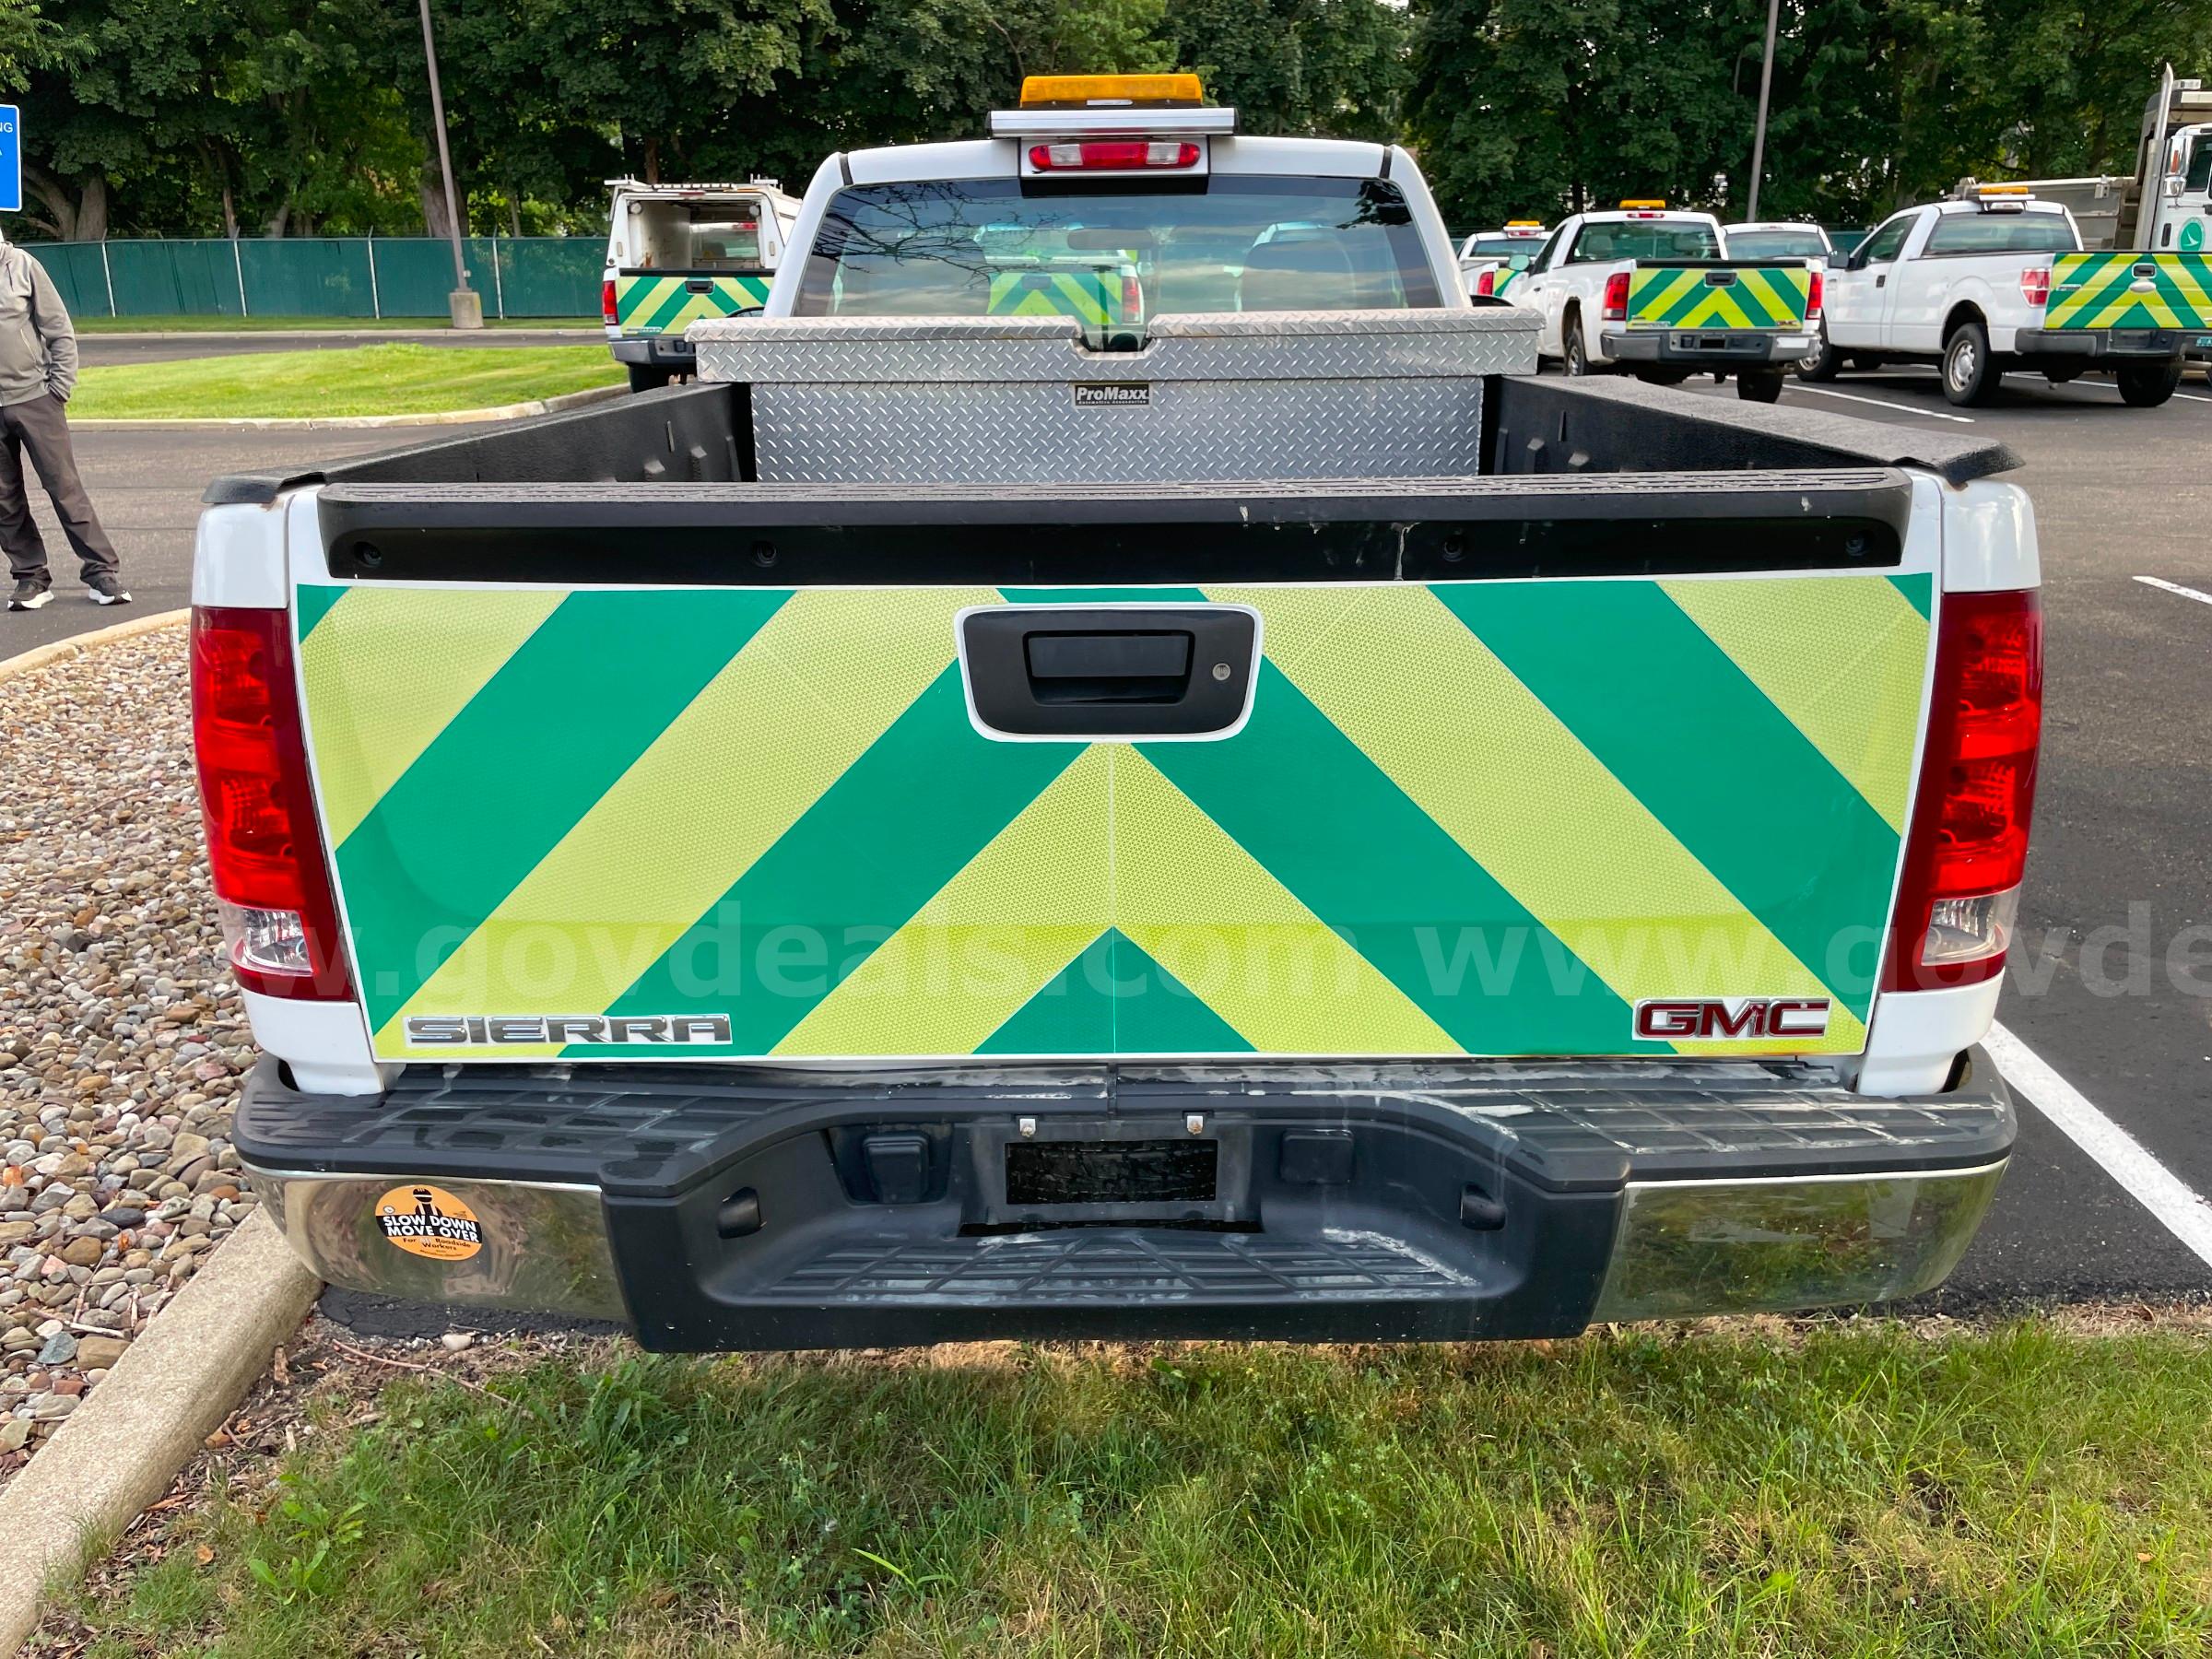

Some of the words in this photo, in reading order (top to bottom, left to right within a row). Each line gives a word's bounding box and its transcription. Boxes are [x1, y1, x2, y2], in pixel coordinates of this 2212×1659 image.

[0, 122, 14, 134] G
[1077, 386, 1148, 401] ProMaxx
[406, 1013, 731, 1043] SIERRA
[1633, 999, 1830, 1040] GMC
[382, 1215, 426, 1227] SLOW
[429, 1216, 477, 1231] DOWN
[387, 1225, 435, 1237] MOVE
[439, 1227, 479, 1243] OVER
